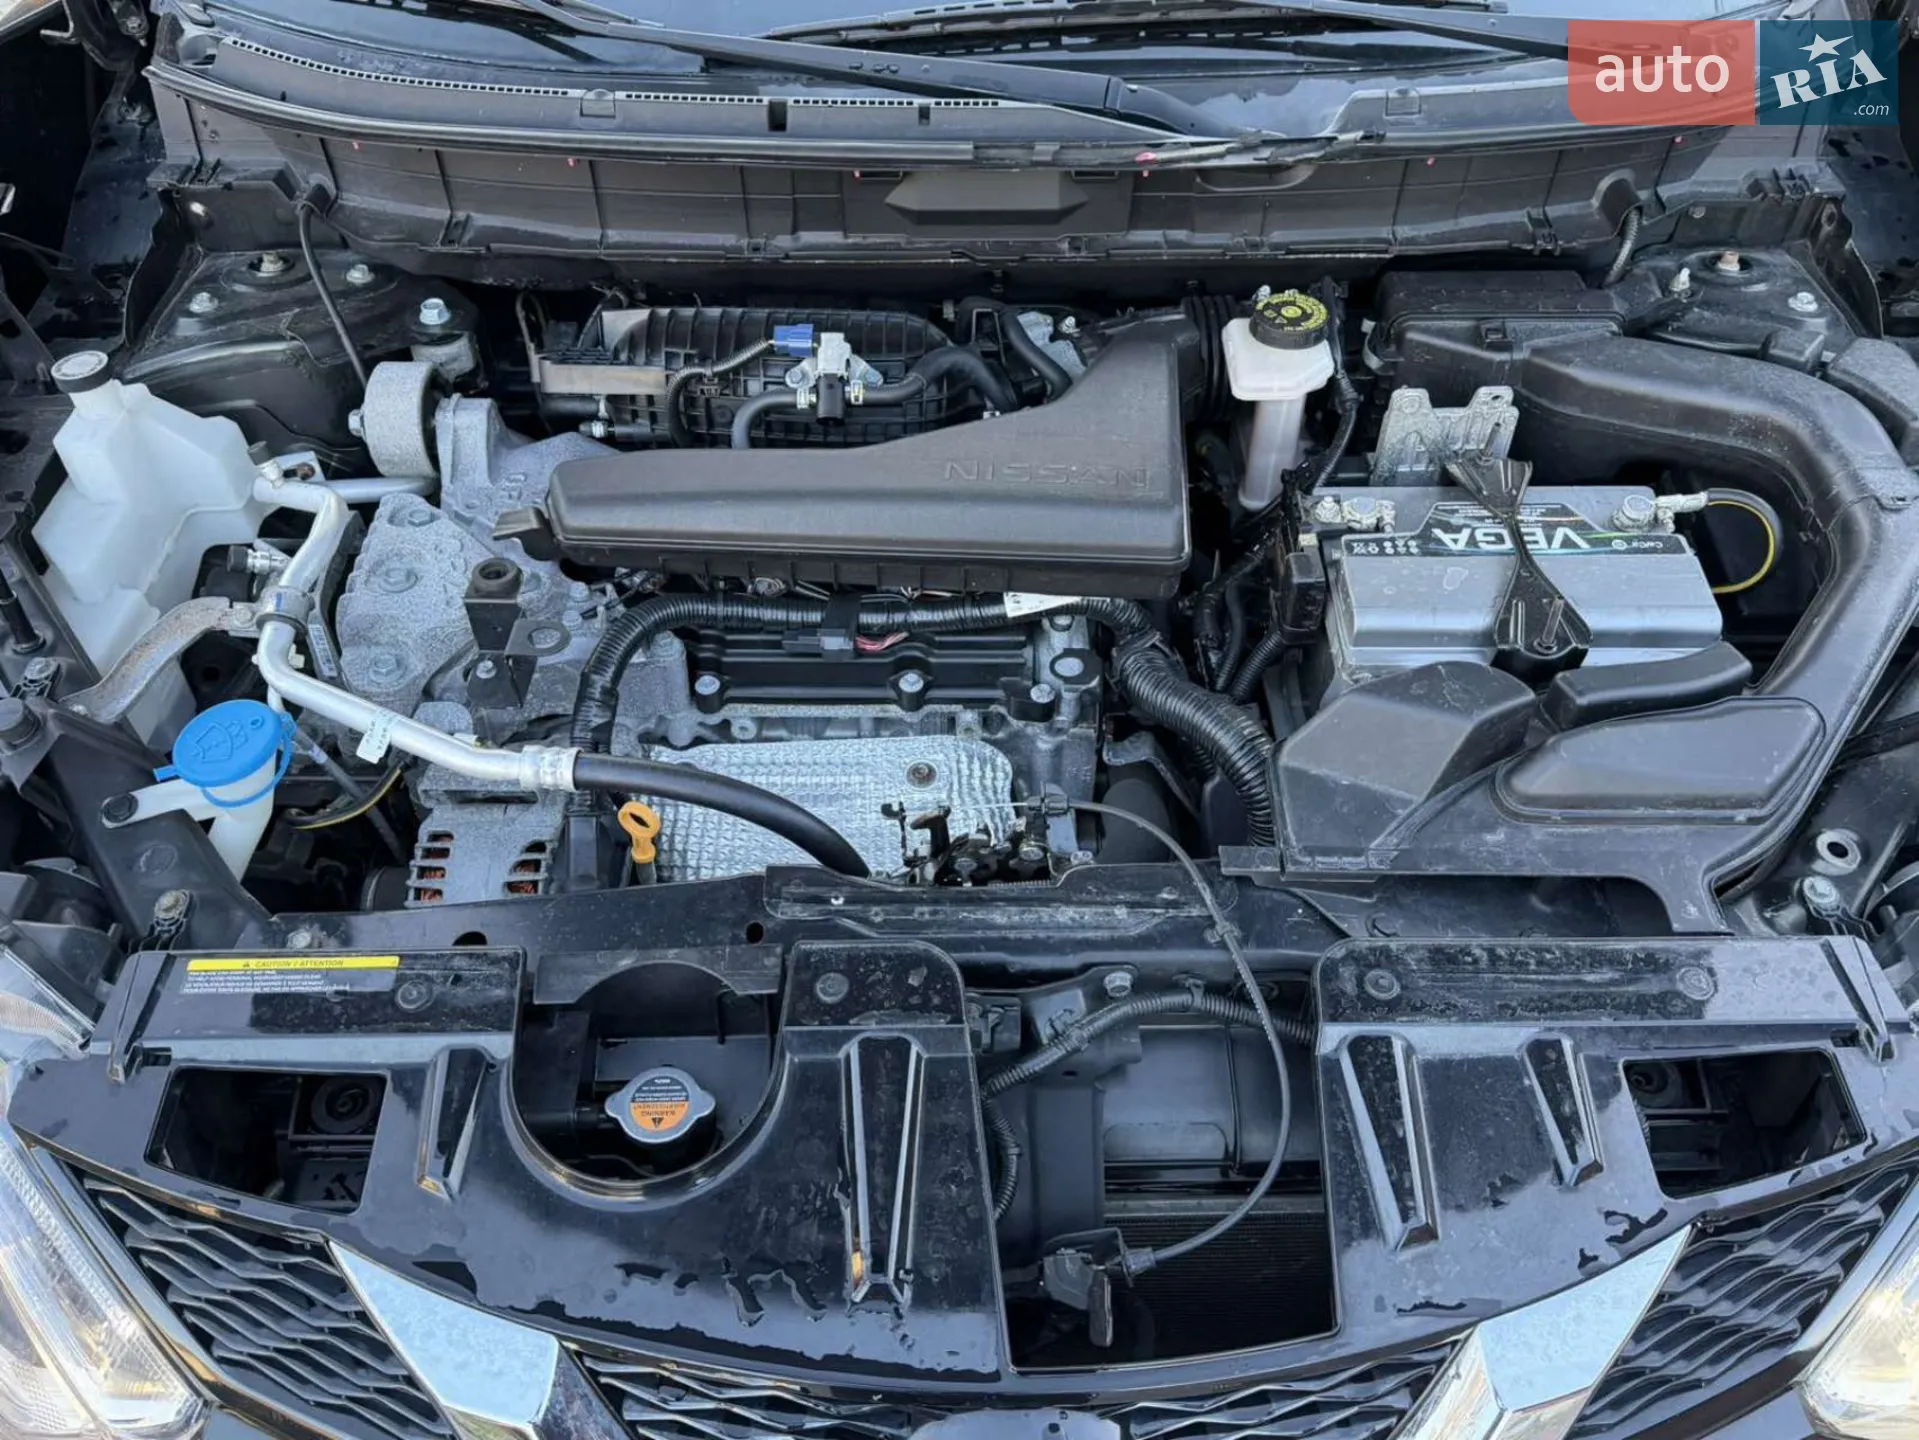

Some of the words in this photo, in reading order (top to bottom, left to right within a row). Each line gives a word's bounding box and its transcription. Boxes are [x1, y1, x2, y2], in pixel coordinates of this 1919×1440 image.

[945, 459, 1150, 488] NISSAN
[1432, 526, 1592, 551] VEGA
[254, 960, 291, 968] CAUTION
[299, 959, 344, 967] ATTENTION
